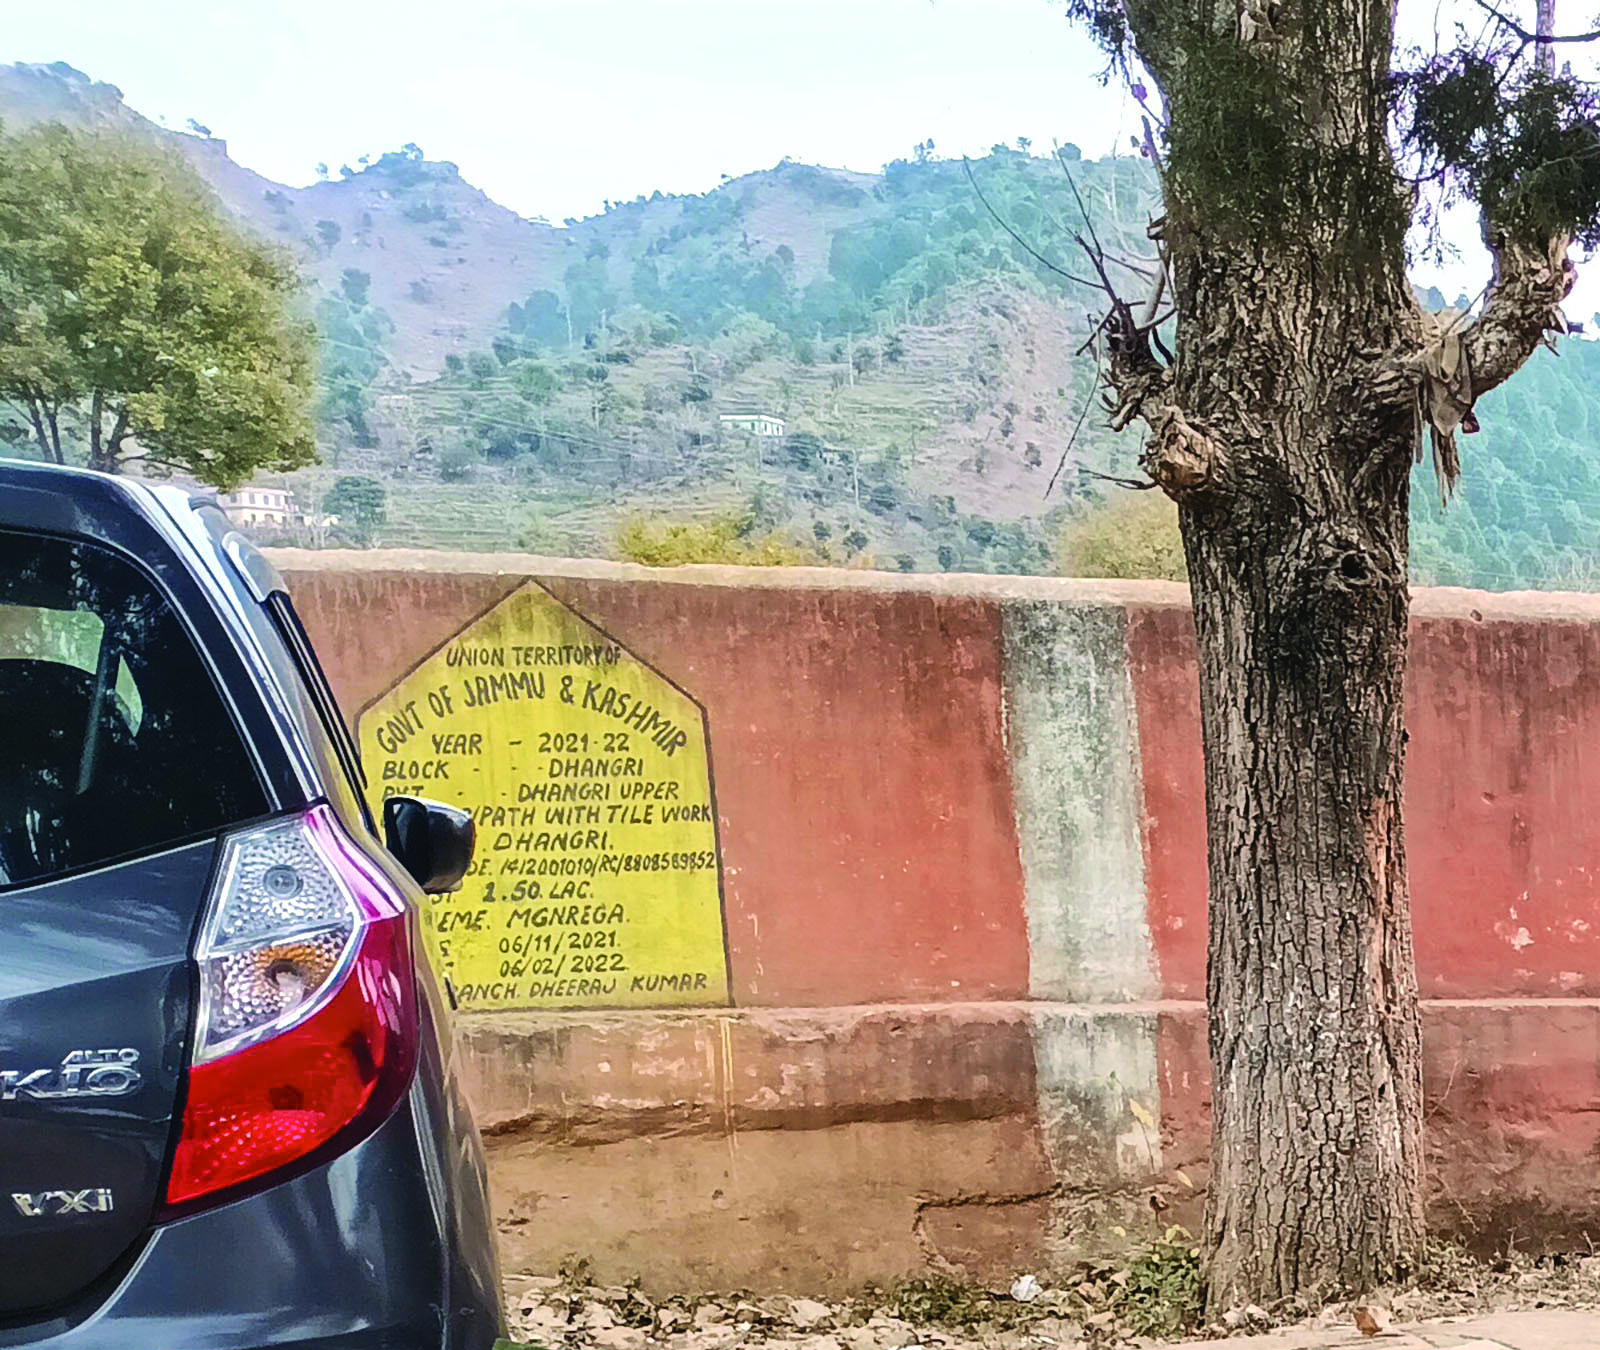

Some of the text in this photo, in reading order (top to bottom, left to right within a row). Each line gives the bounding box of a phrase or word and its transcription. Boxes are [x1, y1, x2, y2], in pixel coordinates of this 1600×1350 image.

[446, 645, 621, 667] UNION TERRITORY OF
[376, 671, 687, 757] GOVT OF JAMMU & KASHMIR
[431, 733, 483, 755] YEAR
[382, 758, 644, 780] BLOCK DHANGRI
[518, 783, 610, 802] DHANGRI
[620, 781, 680, 801] UPPER
[545, 805, 601, 826] WITH
[607, 804, 654, 825] TILE
[661, 803, 712, 824] WORK
[529, 977, 617, 998] DHEERAJ
[629, 972, 708, 993] KUMAR
[60, 1048, 140, 1065] ALTO
[0, 1065, 142, 1099] K10
